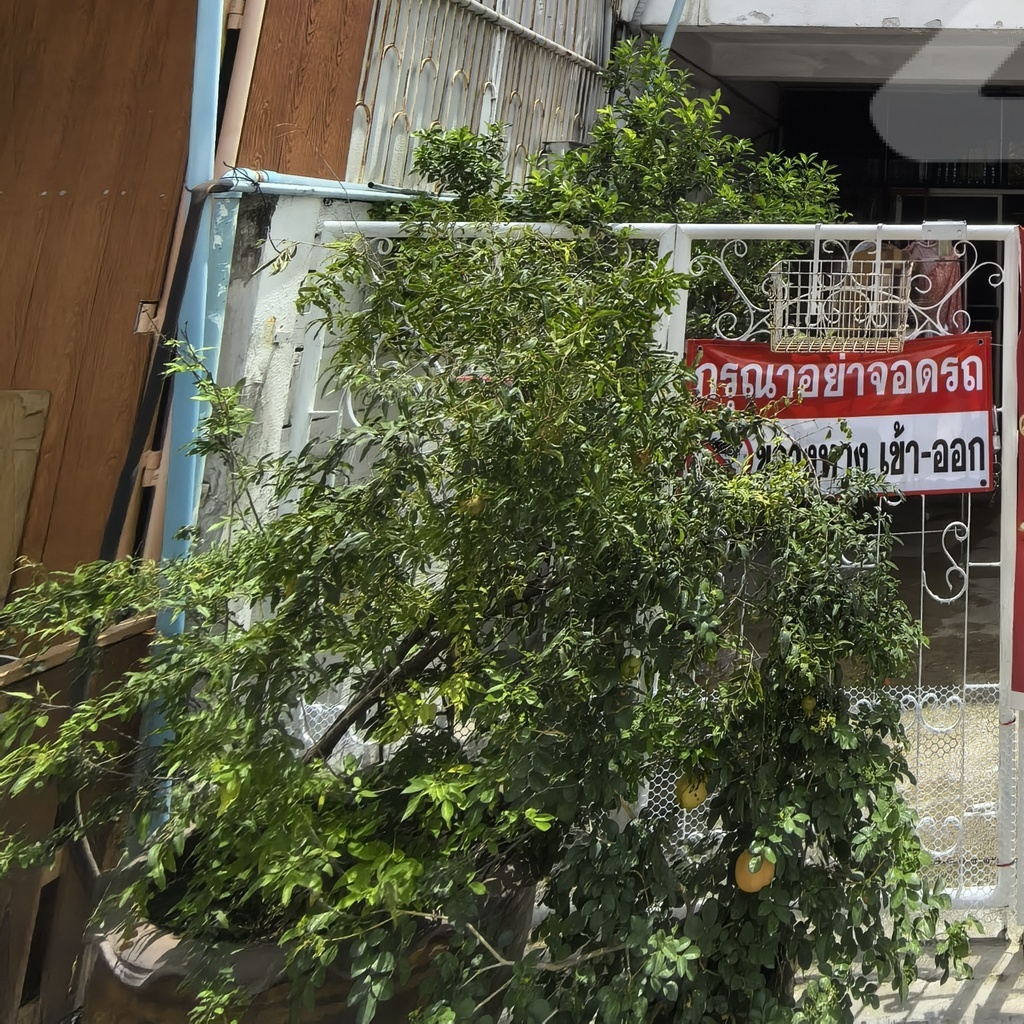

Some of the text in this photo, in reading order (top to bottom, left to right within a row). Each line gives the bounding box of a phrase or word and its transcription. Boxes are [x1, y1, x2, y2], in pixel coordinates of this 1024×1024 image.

[695, 353, 984, 411] กรุณาอย่าจอดรถ
[880, 421, 986, 476] เข้า-ออก
